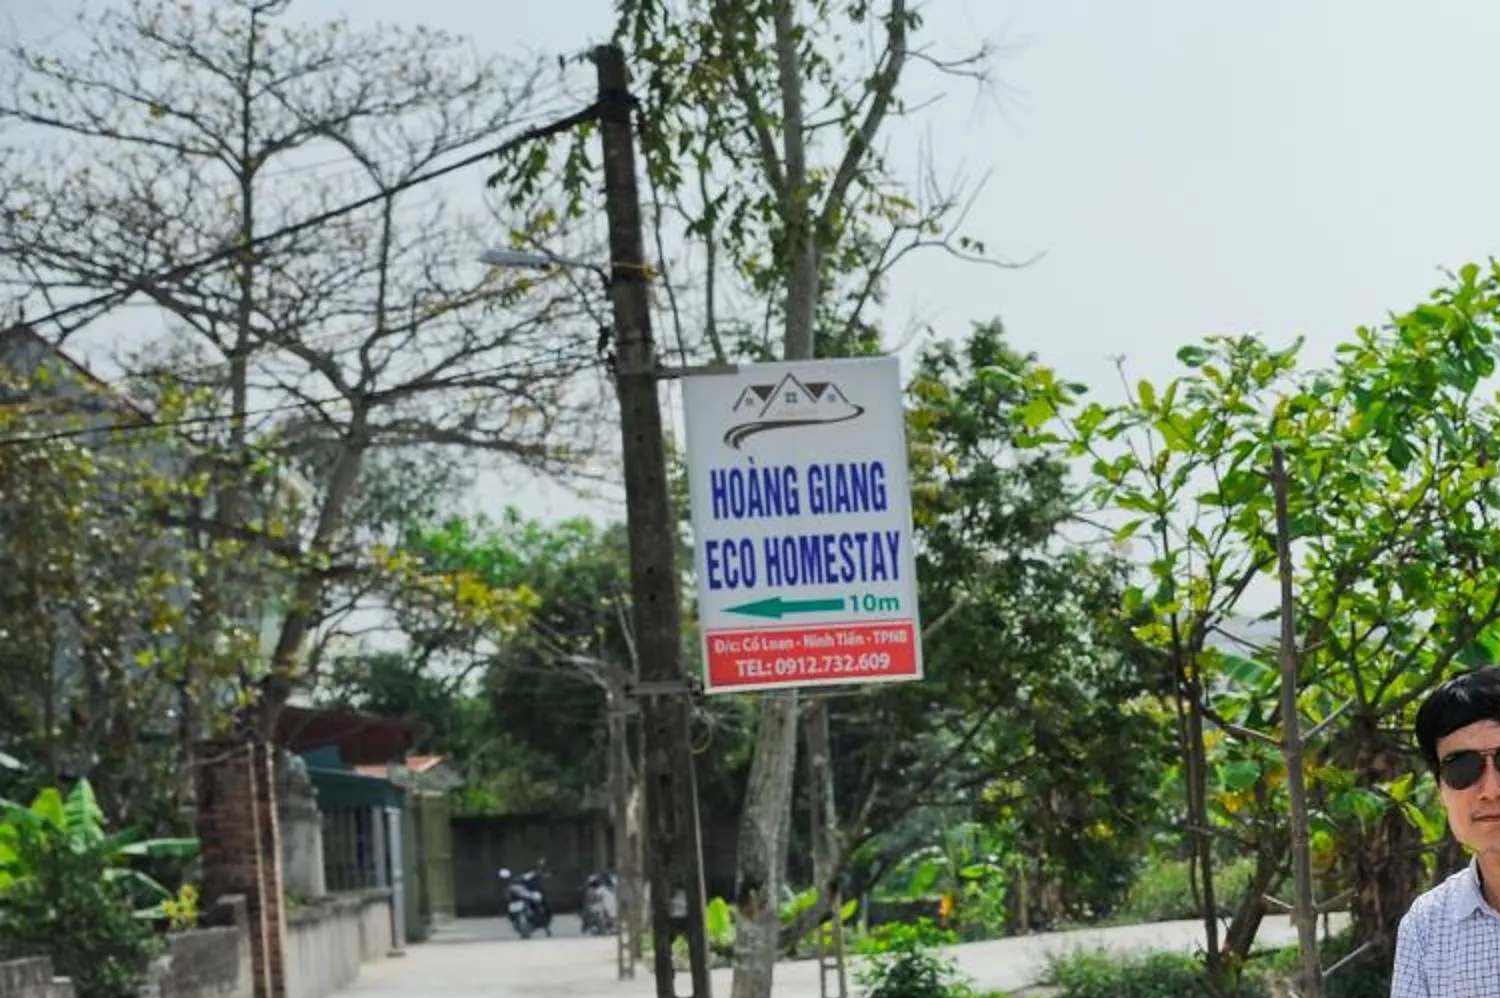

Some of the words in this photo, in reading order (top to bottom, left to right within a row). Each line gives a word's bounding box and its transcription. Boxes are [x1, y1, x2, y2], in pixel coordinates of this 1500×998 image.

[710, 456, 800, 520] HOÀNG
[808, 461, 887, 515] GIANG
[705, 538, 757, 590] ECO
[764, 531, 900, 587] HOMESTAY
[849, 593, 900, 612] 10m
[735, 658, 773, 678] TEL:
[775, 652, 892, 676] 0912.732.609
